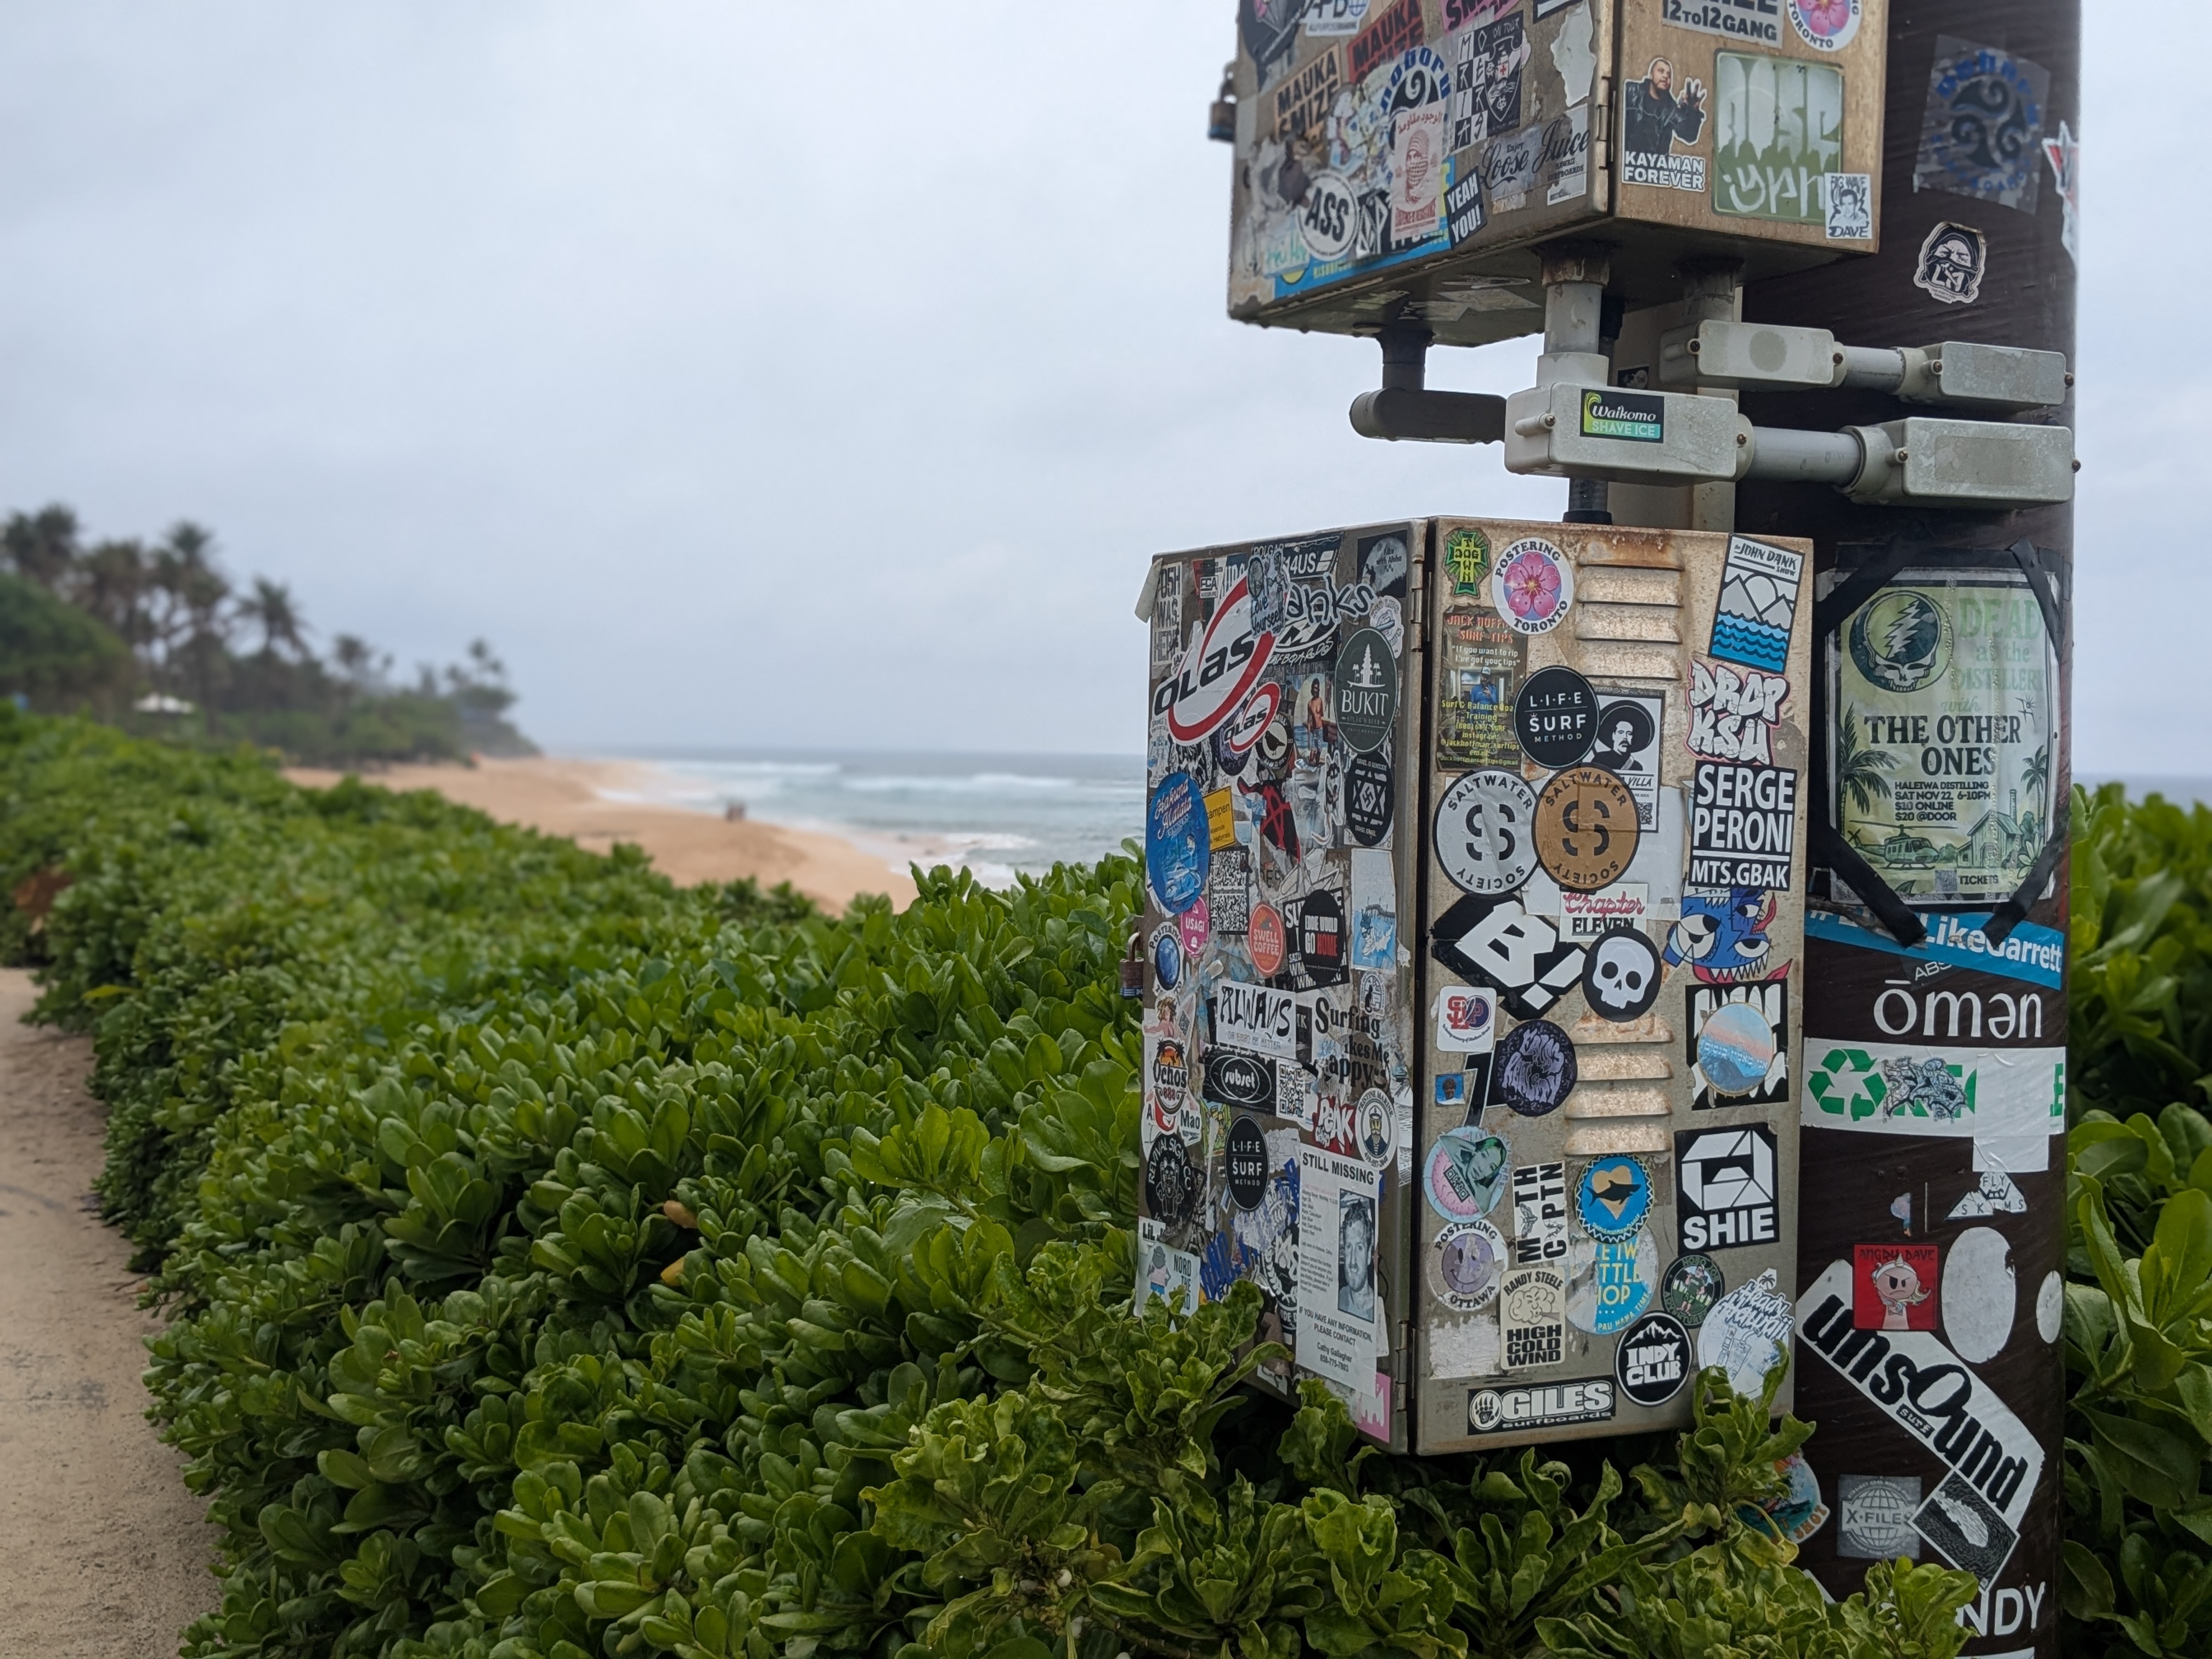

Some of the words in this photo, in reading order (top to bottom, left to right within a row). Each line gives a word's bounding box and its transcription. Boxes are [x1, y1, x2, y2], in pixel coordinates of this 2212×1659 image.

[1788, 1, 1834, 49] TORONTO
[1278, 51, 1337, 117] MAUKA
[1624, 151, 1705, 174] KAYAMAN
[1624, 167, 1704, 190] FOREVER
[1447, 172, 1479, 215] YEAH
[1304, 187, 1349, 242] ASS
[1451, 204, 1481, 244] YOU!
[1829, 221, 1869, 238] DAVE
[1592, 404, 1656, 422] Waikomo
[1592, 421, 1632, 436] SHAVE
[1634, 424, 1656, 437] ICE
[1495, 540, 1561, 579] POSTERING
[1737, 543, 1767, 562] JOHN
[1767, 550, 1798, 571] DANK
[1775, 565, 1797, 577] SHOW
[1514, 600, 1568, 633] TORONTO
[1958, 597, 2042, 639] DEAD
[1499, 648, 1507, 656] to
[1341, 689, 1389, 716] BUKIT
[1940, 696, 1981, 713] with
[1529, 714, 1587, 732] SURF
[1864, 715, 1929, 744] THE
[1937, 714, 2022, 744] OTHER
[1534, 733, 1582, 743] METHOD
[1921, 747, 1997, 776] ONES
[1448, 774, 1533, 811] SALTWATER
[1545, 771, 1627, 807] SALTWATER
[1696, 764, 1795, 812] SERGE
[1894, 781, 1939, 790] HALEIWA
[1940, 781, 1989, 790] DISTILLING
[1894, 791, 1915, 800] SAT
[1916, 791, 1939, 800] NOV
[1894, 801, 1914, 811] $10
[1915, 801, 1954, 811] ONLINE
[1894, 811, 1915, 822] $20
[1916, 812, 1957, 822] @DOOR
[1693, 807, 1793, 853] PERONI
[1456, 865, 1525, 890] SOCIETY
[1553, 860, 1619, 884] SOCIETY
[1691, 859, 1789, 889] MTS.GBAK
[1958, 874, 1999, 885] TICKETS
[1565, 891, 1645, 921] Chapter
[1185, 917, 1205, 933] USAGI
[1253, 928, 1279, 944] SWELL
[1572, 917, 1634, 935] ELEVEN
[1253, 941, 1279, 956] COFFEE
[1305, 932, 1316, 955] GO
[1317, 933, 1338, 957] HOME
[1221, 985, 1293, 1039] ALWAYS
[1314, 997, 1381, 1040] Surfing
[1153, 1059, 1187, 1089] Ochos
[1224, 1068, 1256, 1089] subset
[1317, 1054, 1374, 1091] appy
[1232, 1161, 1262, 1177] SURF
[1302, 1152, 1329, 1172] STILL
[1331, 1160, 1374, 1186] MISSING
[1982, 1174, 2007, 1187] FLY
[1434, 1219, 1498, 1251] POSTERING
[1683, 1206, 1775, 1250] SHIE
[1174, 1254, 1192, 1277] NORD
[1904, 1249, 1936, 1260] DAVE
[1503, 1271, 1533, 1296] RANDY
[1534, 1271, 1565, 1291] STEELE
[1449, 1284, 1496, 1308] OTTAWA
[1299, 1306, 1304, 1314] IF
[1304, 1308, 1314, 1319] YOU
[1314, 1311, 1327, 1324] HAVE
[1327, 1317, 1338, 1328] ANY
[1597, 1321, 1613, 1331] PAU
[1635, 1293, 1650, 1311] TIME
[1313, 1322, 1332, 1338] PLEASE
[1333, 1330, 1356, 1346] CONTACT
[1506, 1324, 1562, 1342] HIGH
[1506, 1337, 1561, 1355] COLD
[1506, 1350, 1561, 1367] WIND
[1626, 1360, 1681, 1386] CLUB
[1502, 1381, 1612, 1420] GILES
[1502, 1411, 1612, 1429] surfboards
